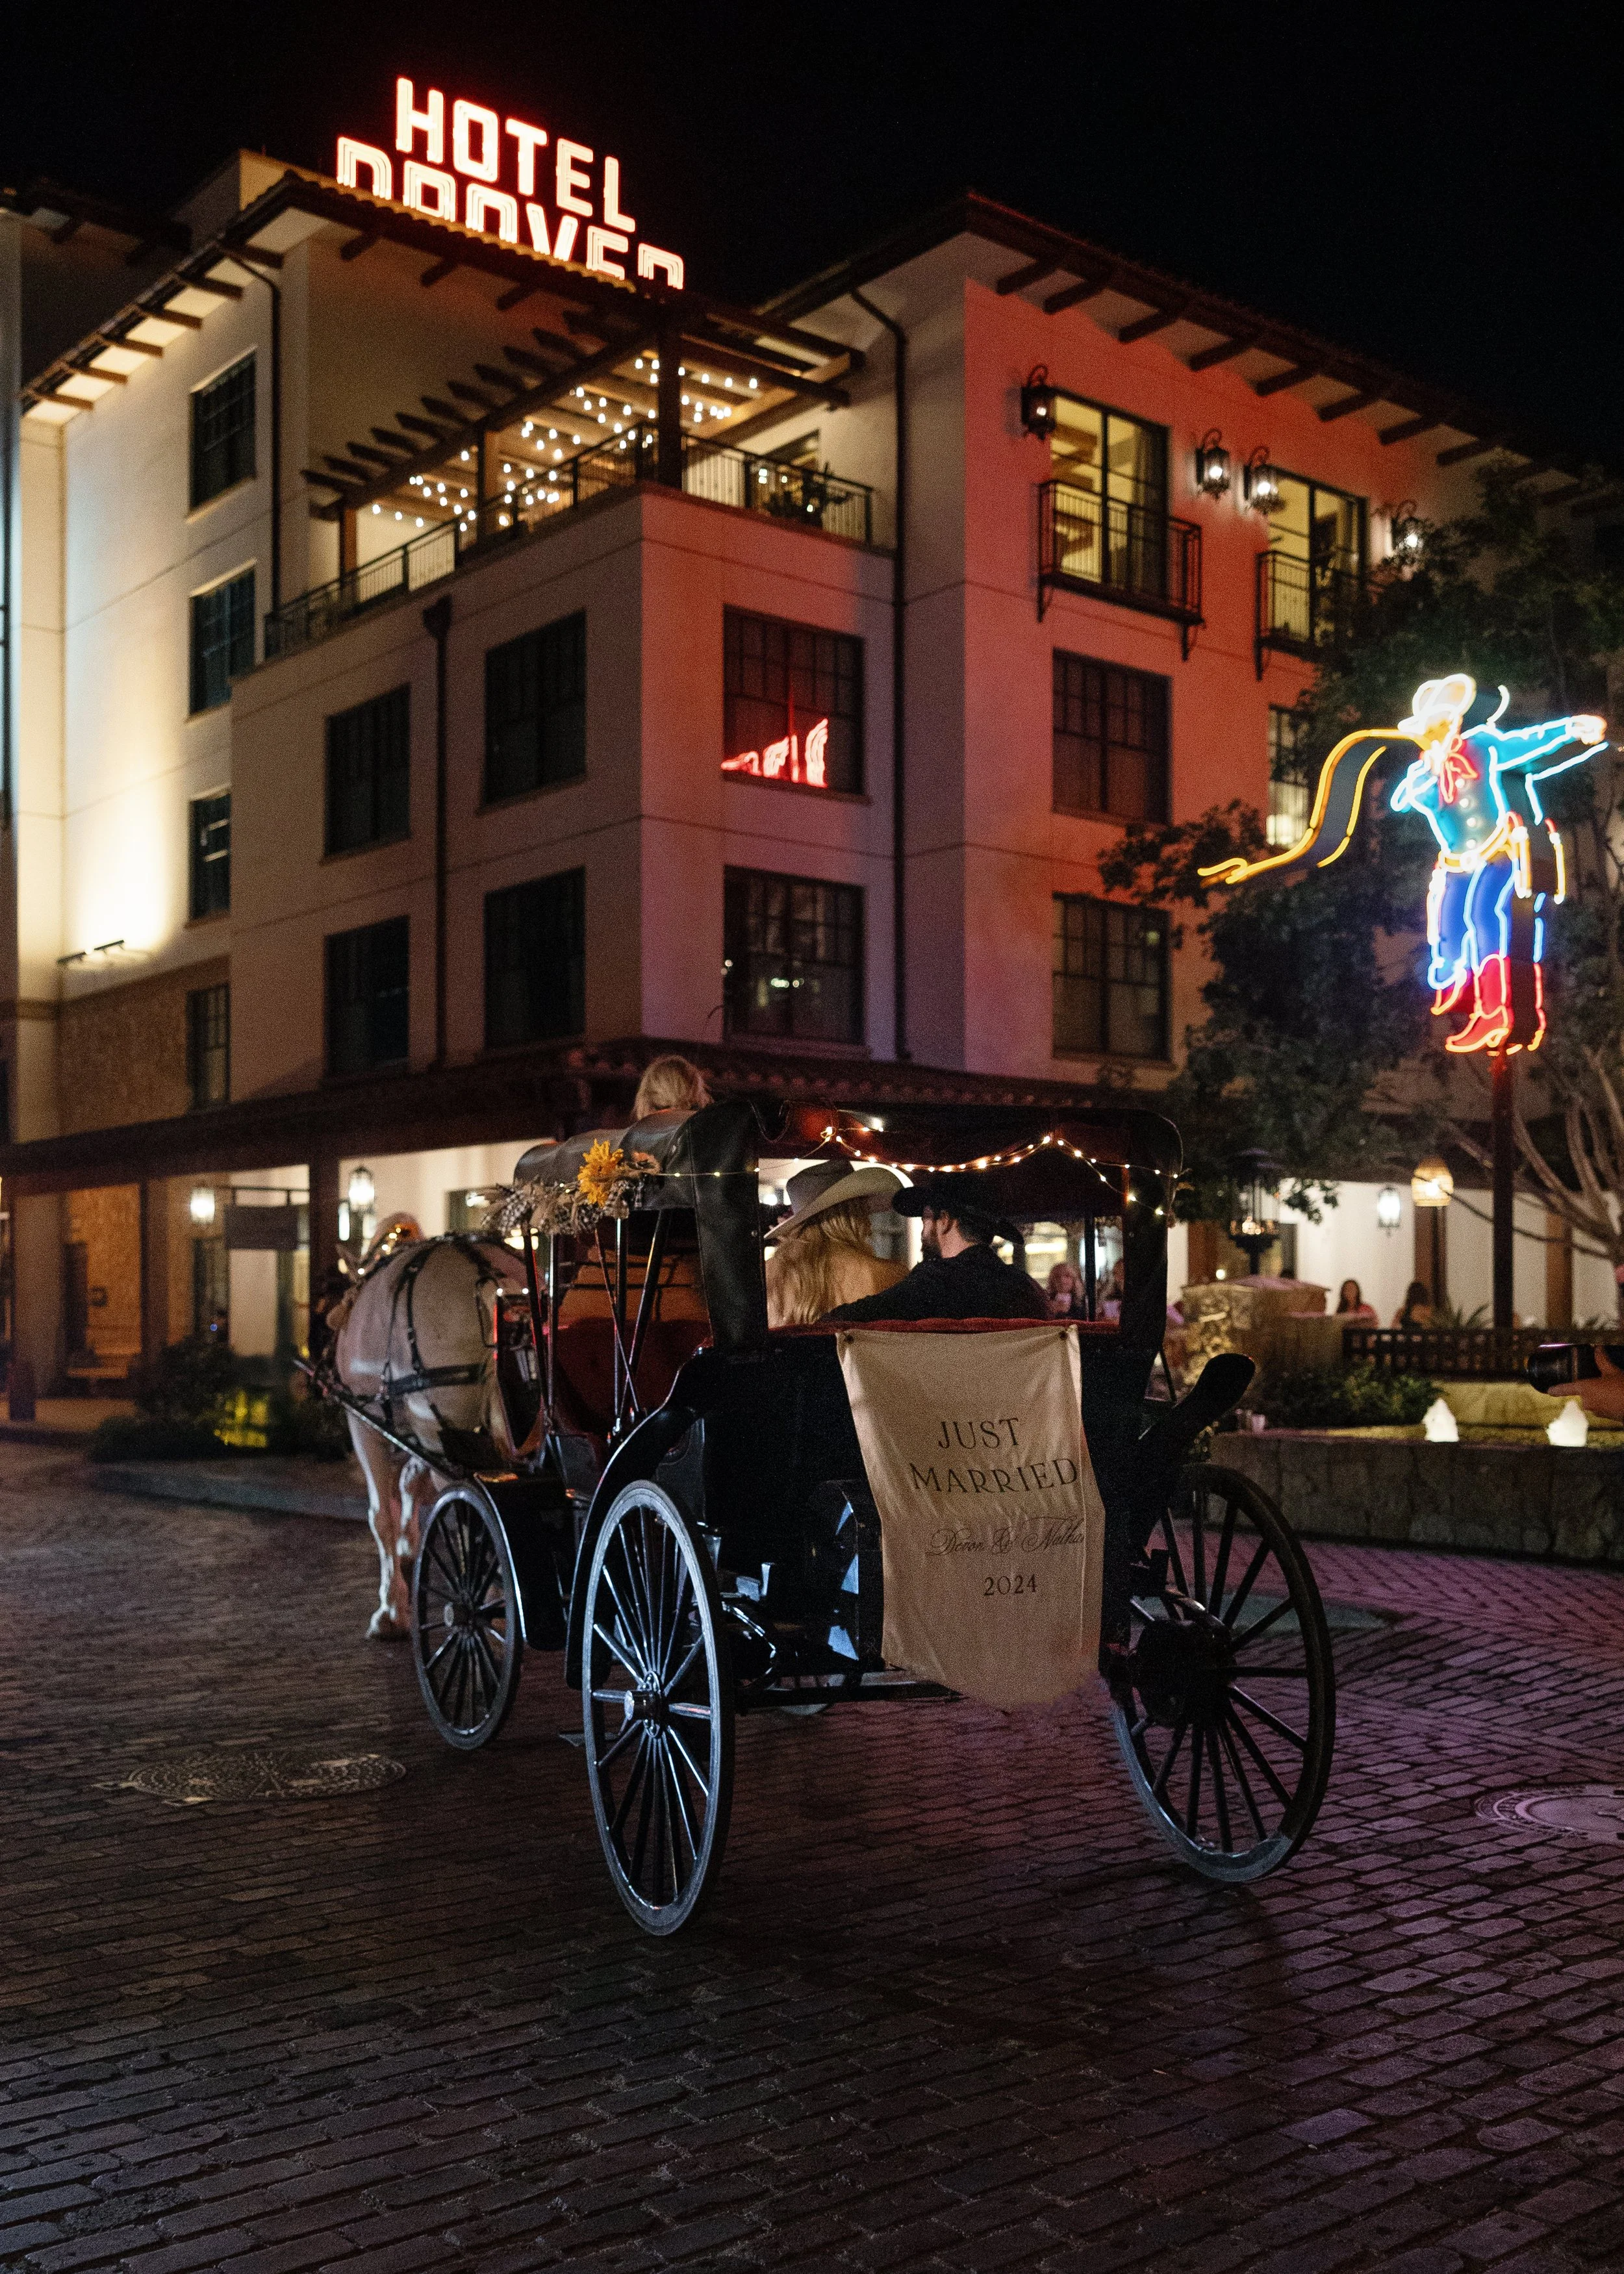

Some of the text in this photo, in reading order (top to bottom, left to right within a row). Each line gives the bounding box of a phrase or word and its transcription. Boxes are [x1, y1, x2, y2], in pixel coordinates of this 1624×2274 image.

[396, 77, 635, 233] HOTEL
[937, 1417, 1019, 1449] JUST
[909, 1457, 1078, 1495] MARRIED
[991, 1525, 1019, 1556] &
[1021, 1514, 1085, 1553] Natha
[983, 1573, 1038, 1597] 2024
